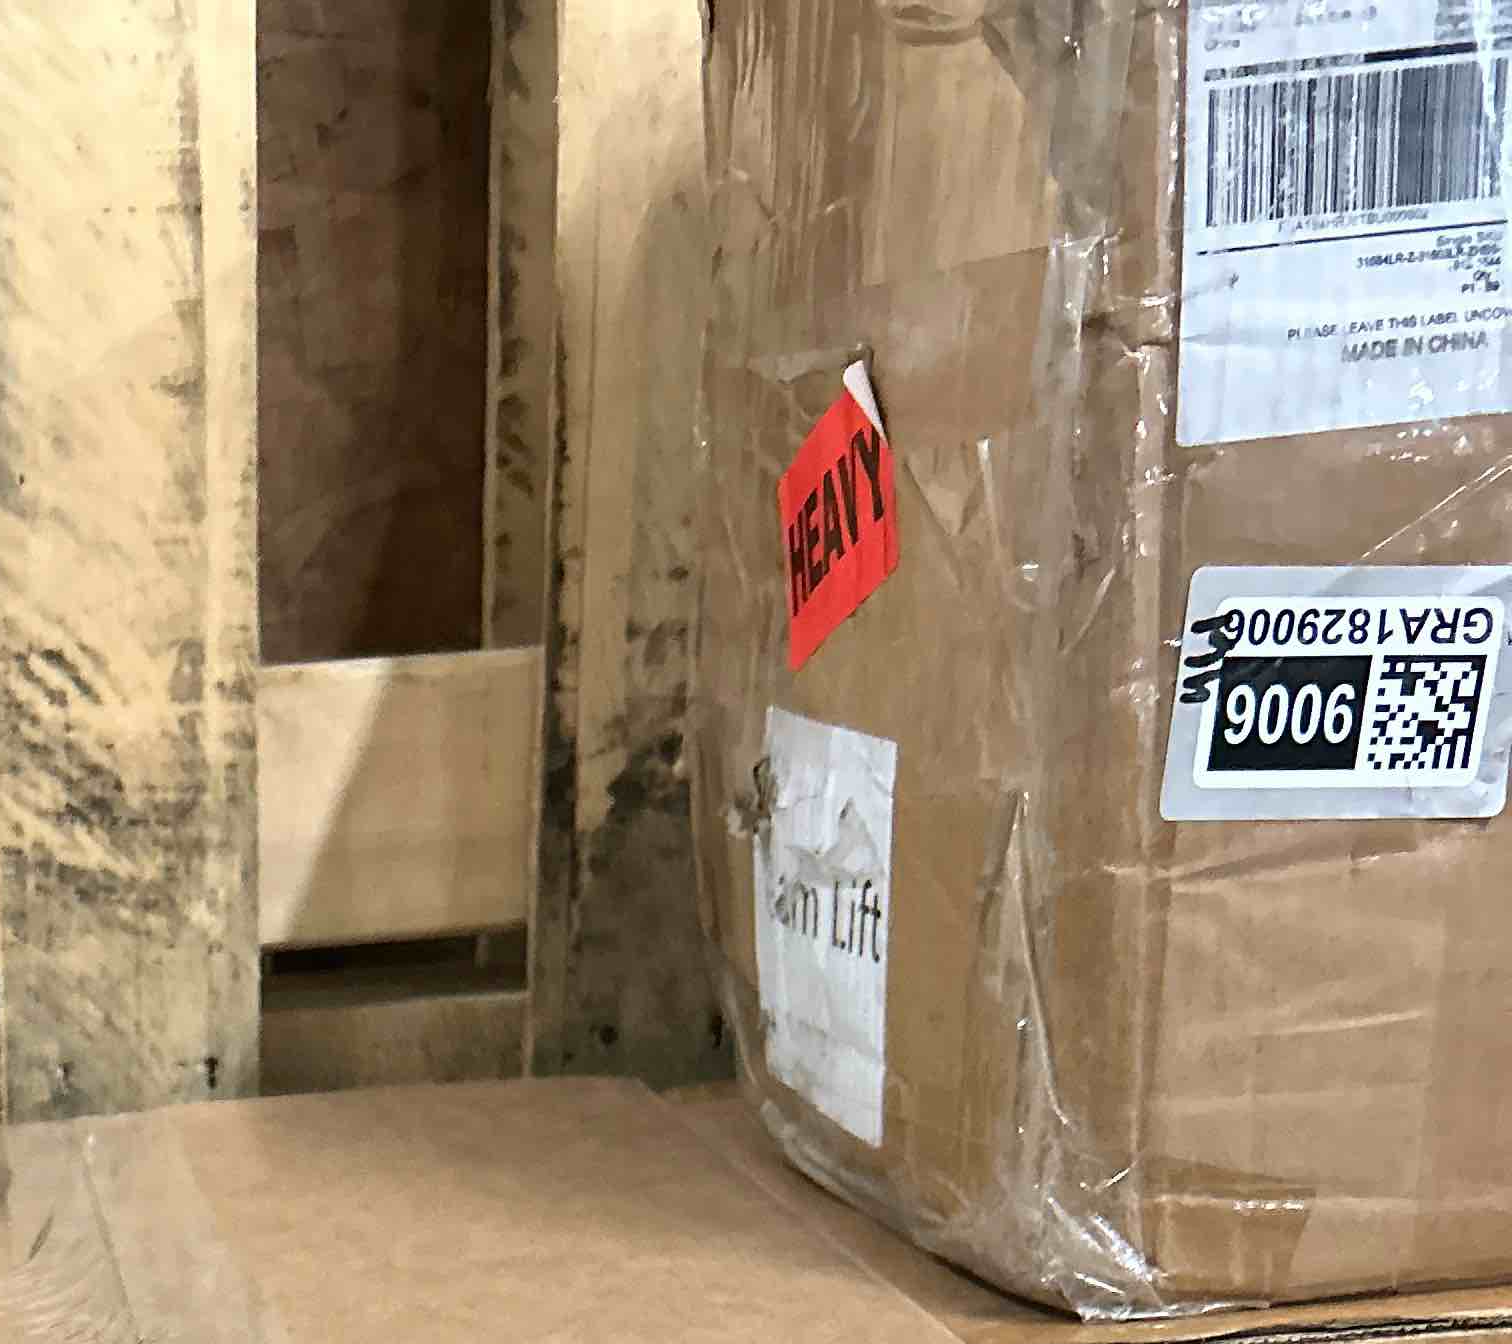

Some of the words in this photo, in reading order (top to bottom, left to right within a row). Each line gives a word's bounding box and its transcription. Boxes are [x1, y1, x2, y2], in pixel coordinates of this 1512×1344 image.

[1387, 315, 1417, 330] THIS
[1341, 339, 1400, 363] MADE
[1402, 336, 1423, 357] IN
[1428, 331, 1489, 354] CHINA
[788, 428, 884, 617] HEAVY
[1224, 607, 1494, 645] GRA1829006
[1224, 684, 1356, 746] 9006
